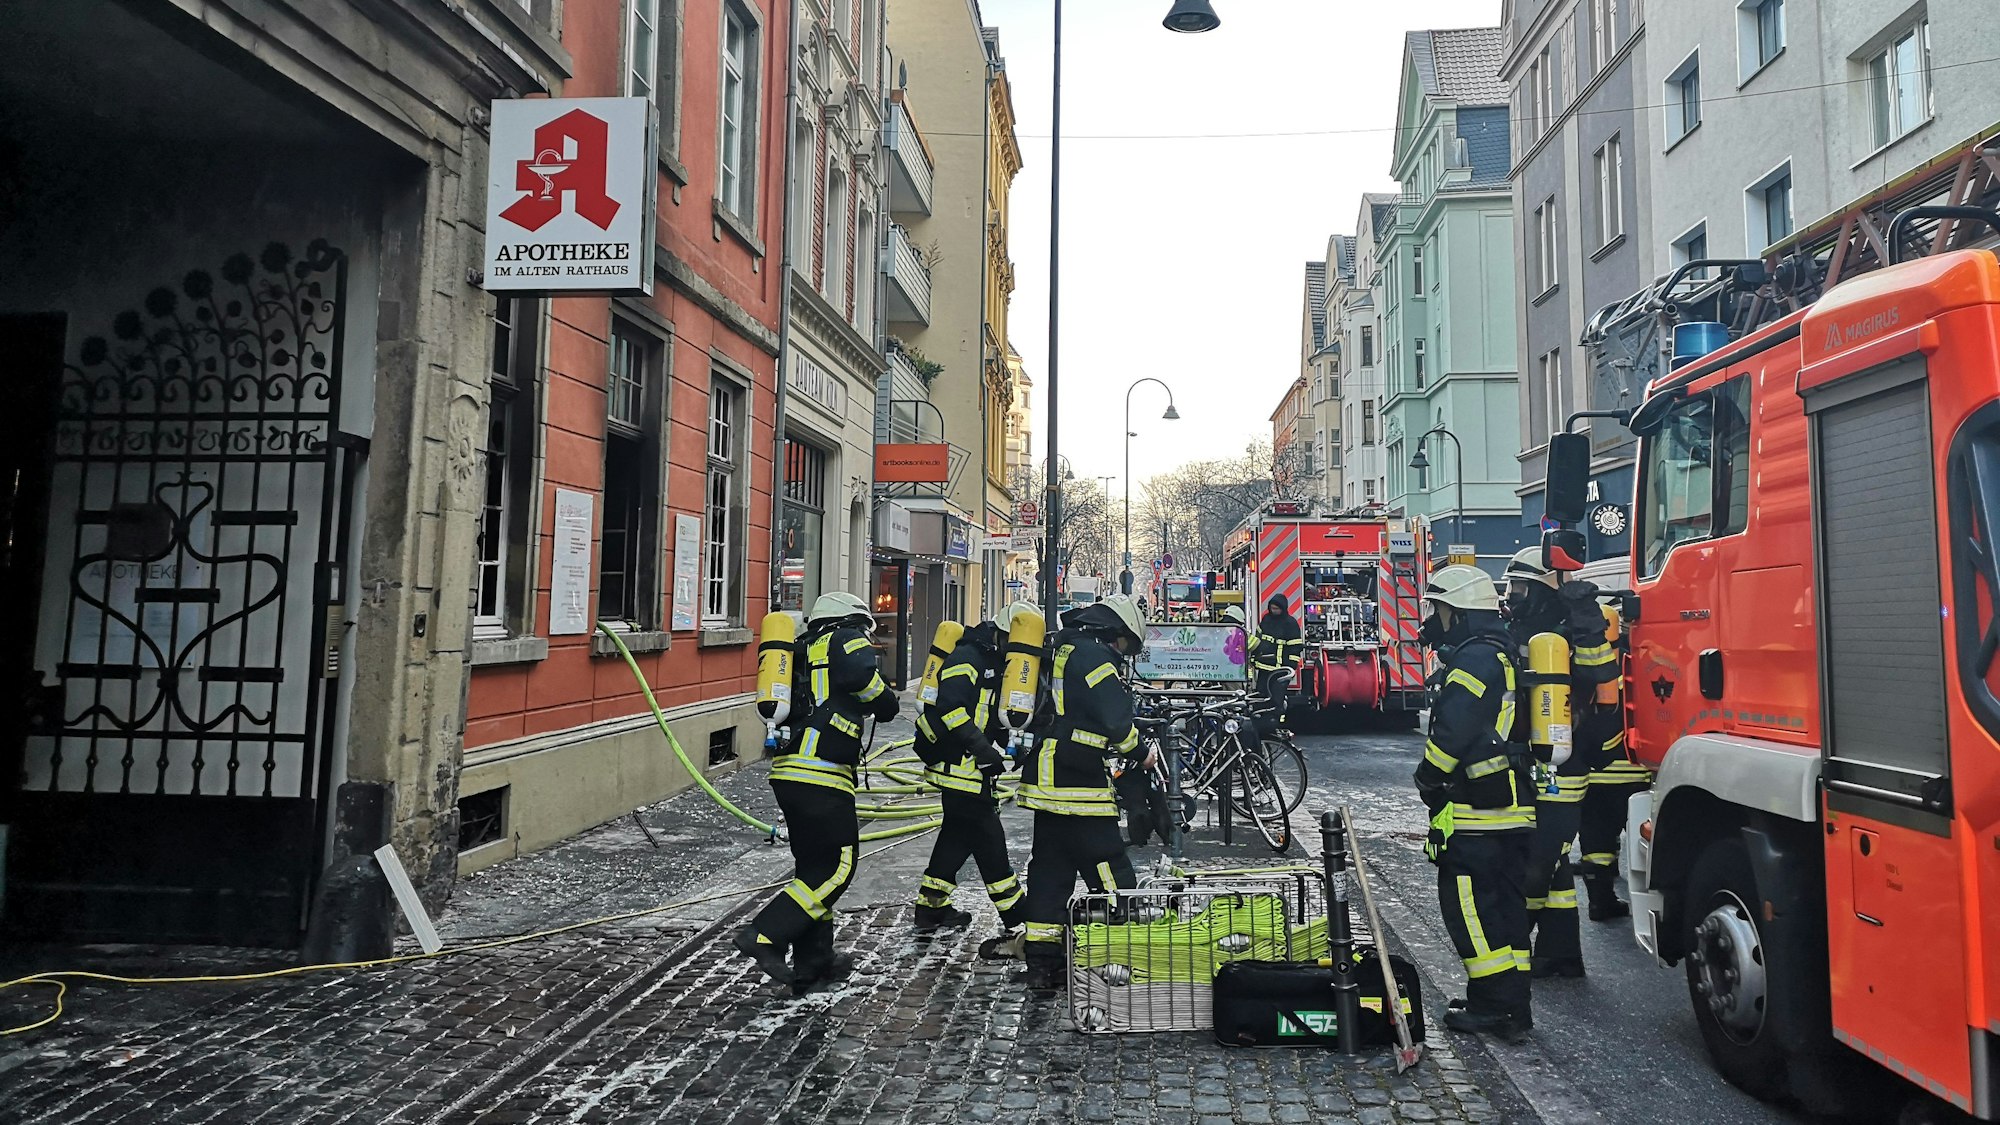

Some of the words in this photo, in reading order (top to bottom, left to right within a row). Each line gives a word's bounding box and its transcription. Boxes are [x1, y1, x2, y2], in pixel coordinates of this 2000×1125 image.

[494, 243, 630, 261] APOTHEKE
[494, 266, 512, 276] IM
[515, 266, 561, 276] ALTEN
[566, 265, 629, 275] RATHAUS
[1844, 306, 1900, 343] MAGIRUS
[795, 353, 824, 402] BAUTEAM
[1600, 518, 1626, 536] BARISTA
[1020, 660, 1030, 684] Dräger
[1542, 690, 1550, 716] Dräger
